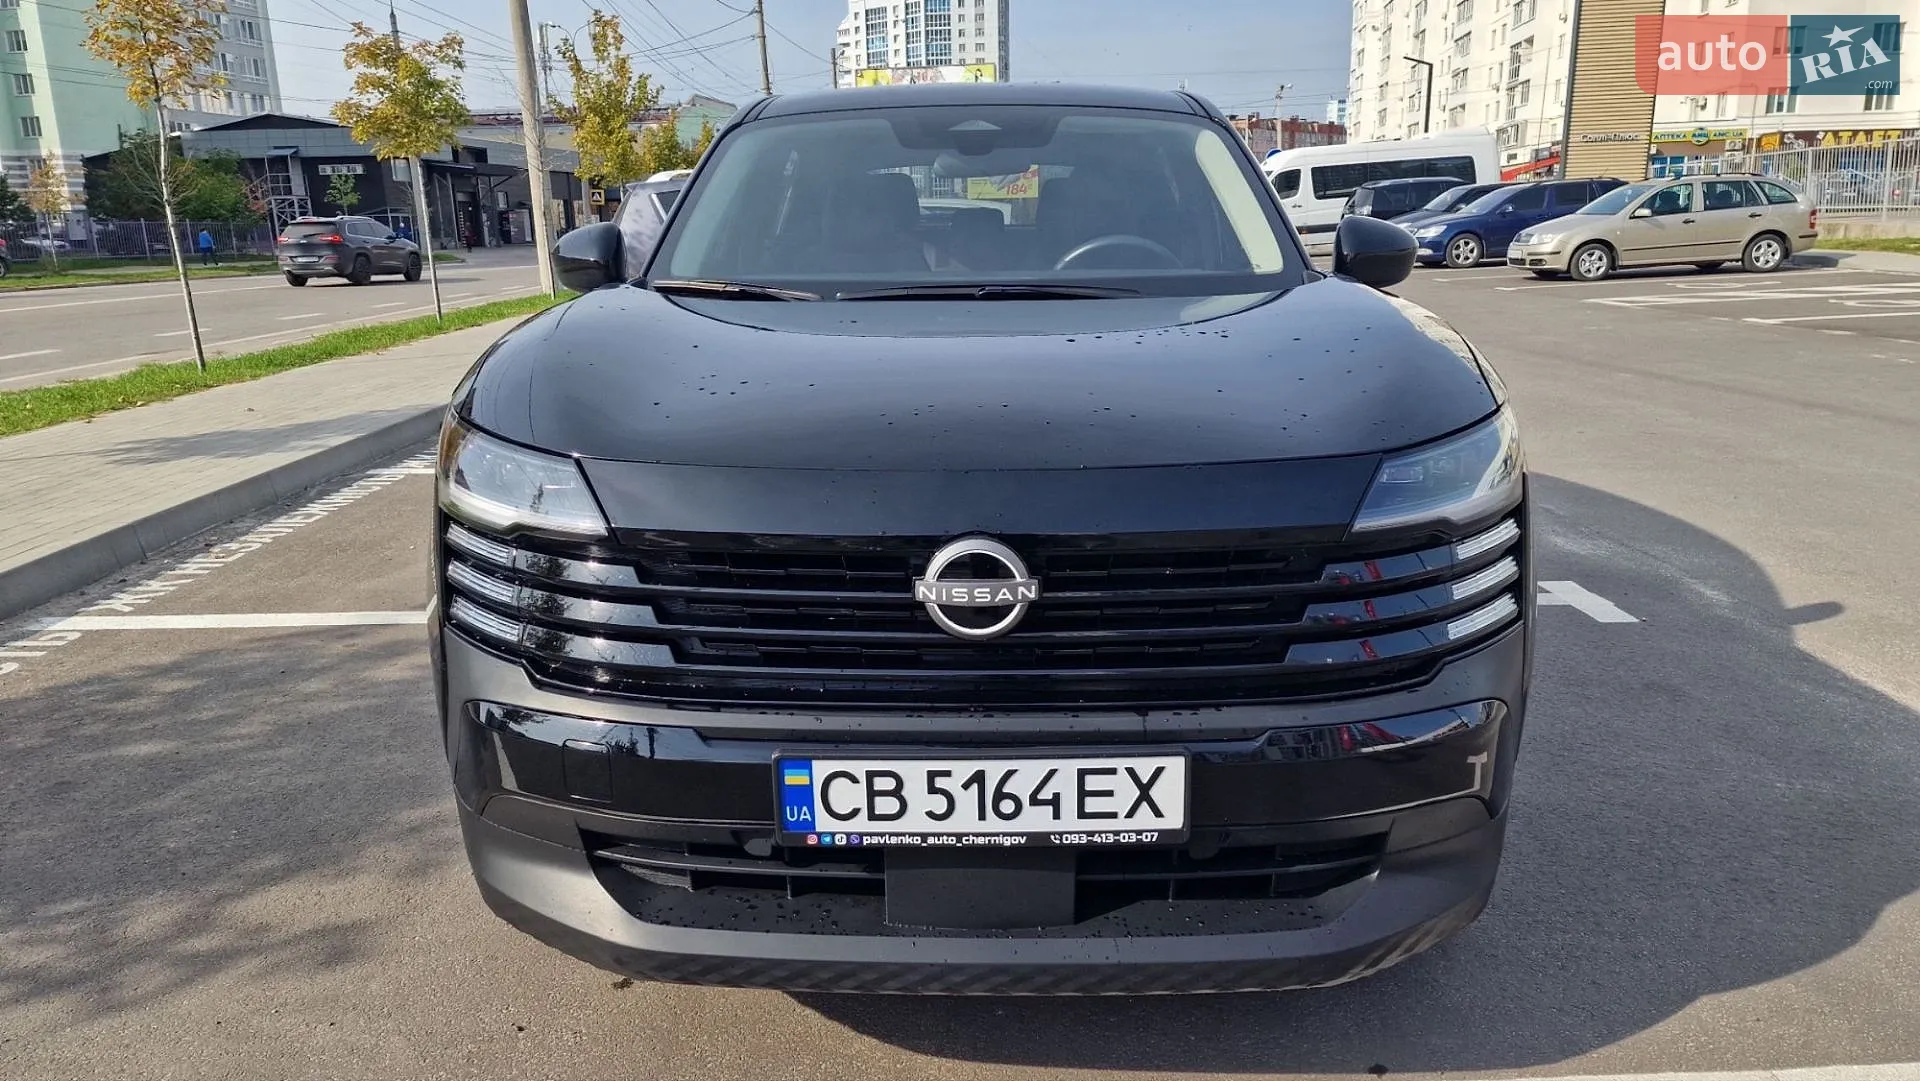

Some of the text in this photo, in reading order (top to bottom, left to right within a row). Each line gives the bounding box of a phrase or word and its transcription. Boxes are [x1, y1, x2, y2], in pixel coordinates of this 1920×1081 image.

[919, 585, 1036, 602] NISSAN
[819, 765, 1167, 822] CB 5164 EX
[786, 806, 812, 822] UA
[862, 833, 1027, 846] pavlenko_auto_chernigov
[1062, 832, 1159, 844] 093-413-03-07
